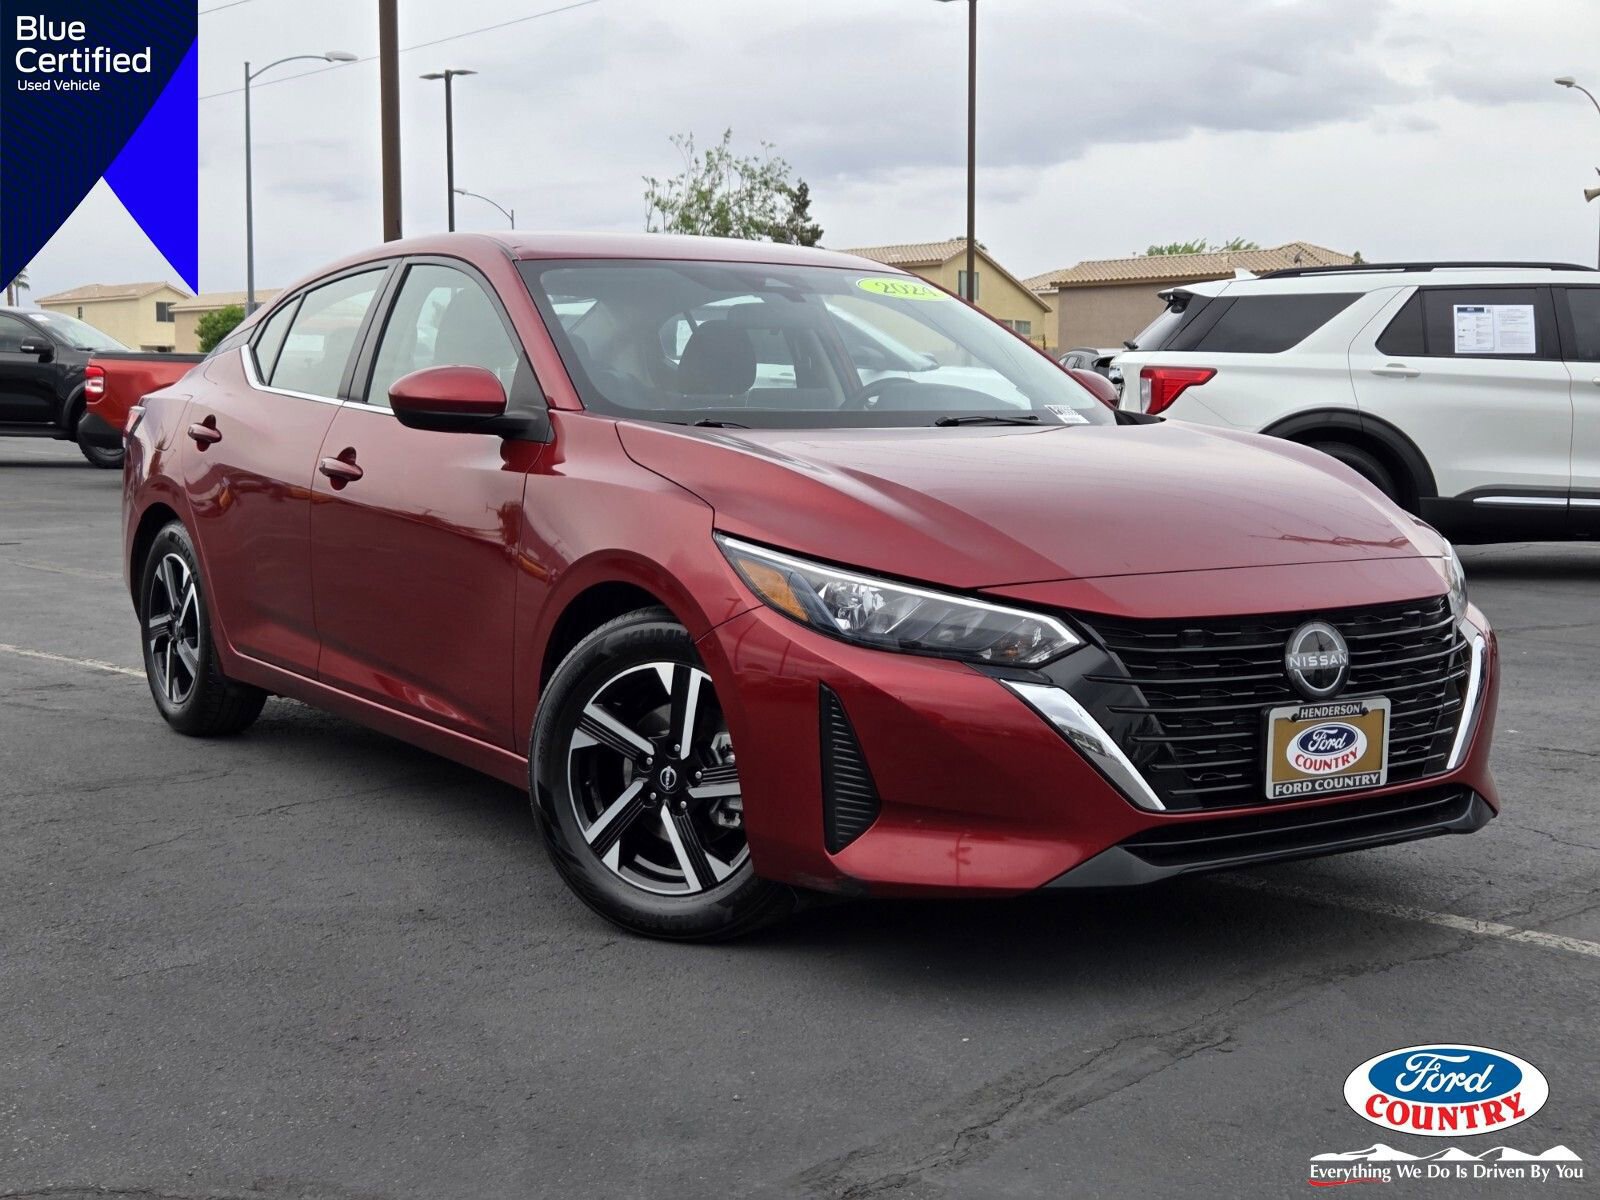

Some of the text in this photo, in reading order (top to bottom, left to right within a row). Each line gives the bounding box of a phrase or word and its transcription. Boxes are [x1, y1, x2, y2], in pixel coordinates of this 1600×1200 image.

[1289, 654, 1347, 667] NISSAN
[1301, 704, 1360, 718] HENDERSON
[1308, 729, 1346, 752] Ford
[1295, 747, 1358, 771] COUNTRY
[1275, 774, 1379, 795] FORD COUNTRY
